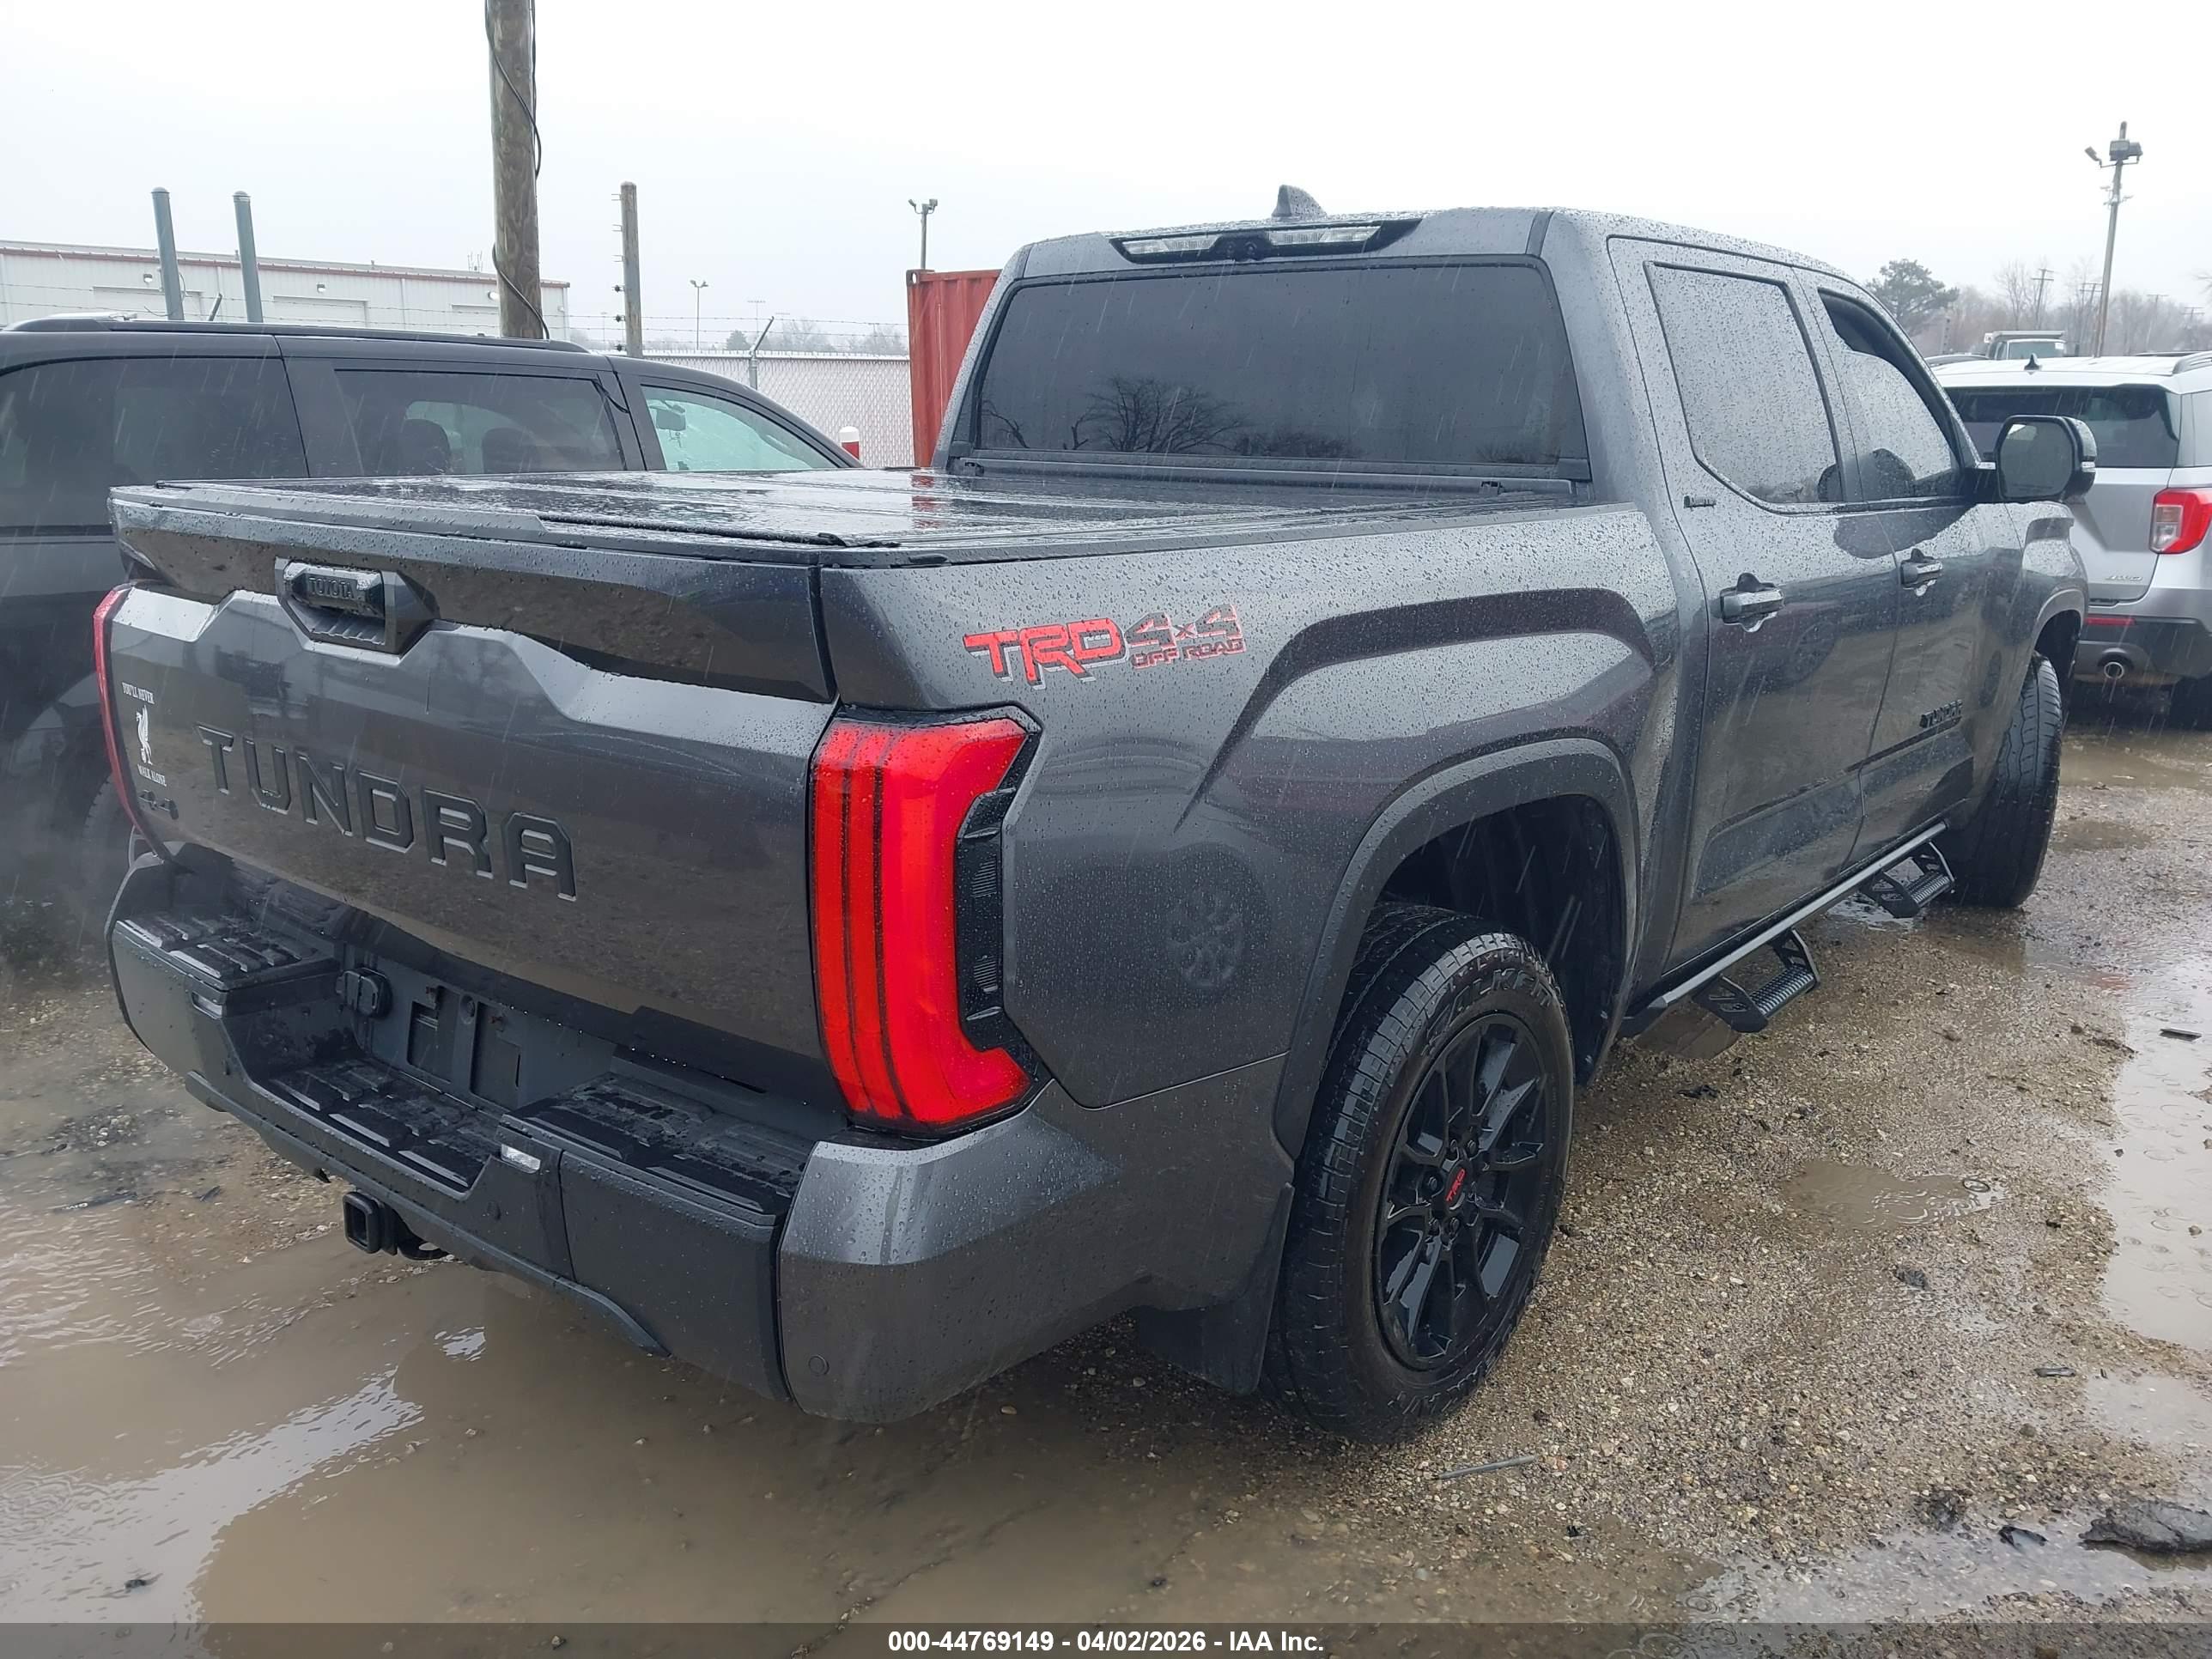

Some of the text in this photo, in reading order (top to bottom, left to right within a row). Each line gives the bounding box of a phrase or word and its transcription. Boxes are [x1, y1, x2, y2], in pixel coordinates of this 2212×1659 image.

[308, 577, 355, 599] TOYOTA
[963, 616, 1128, 690] TRD
[1128, 641, 1247, 672] OFF ROAD
[194, 721, 577, 902] TUNDRA
[1445, 1167, 1467, 1202] TRD
